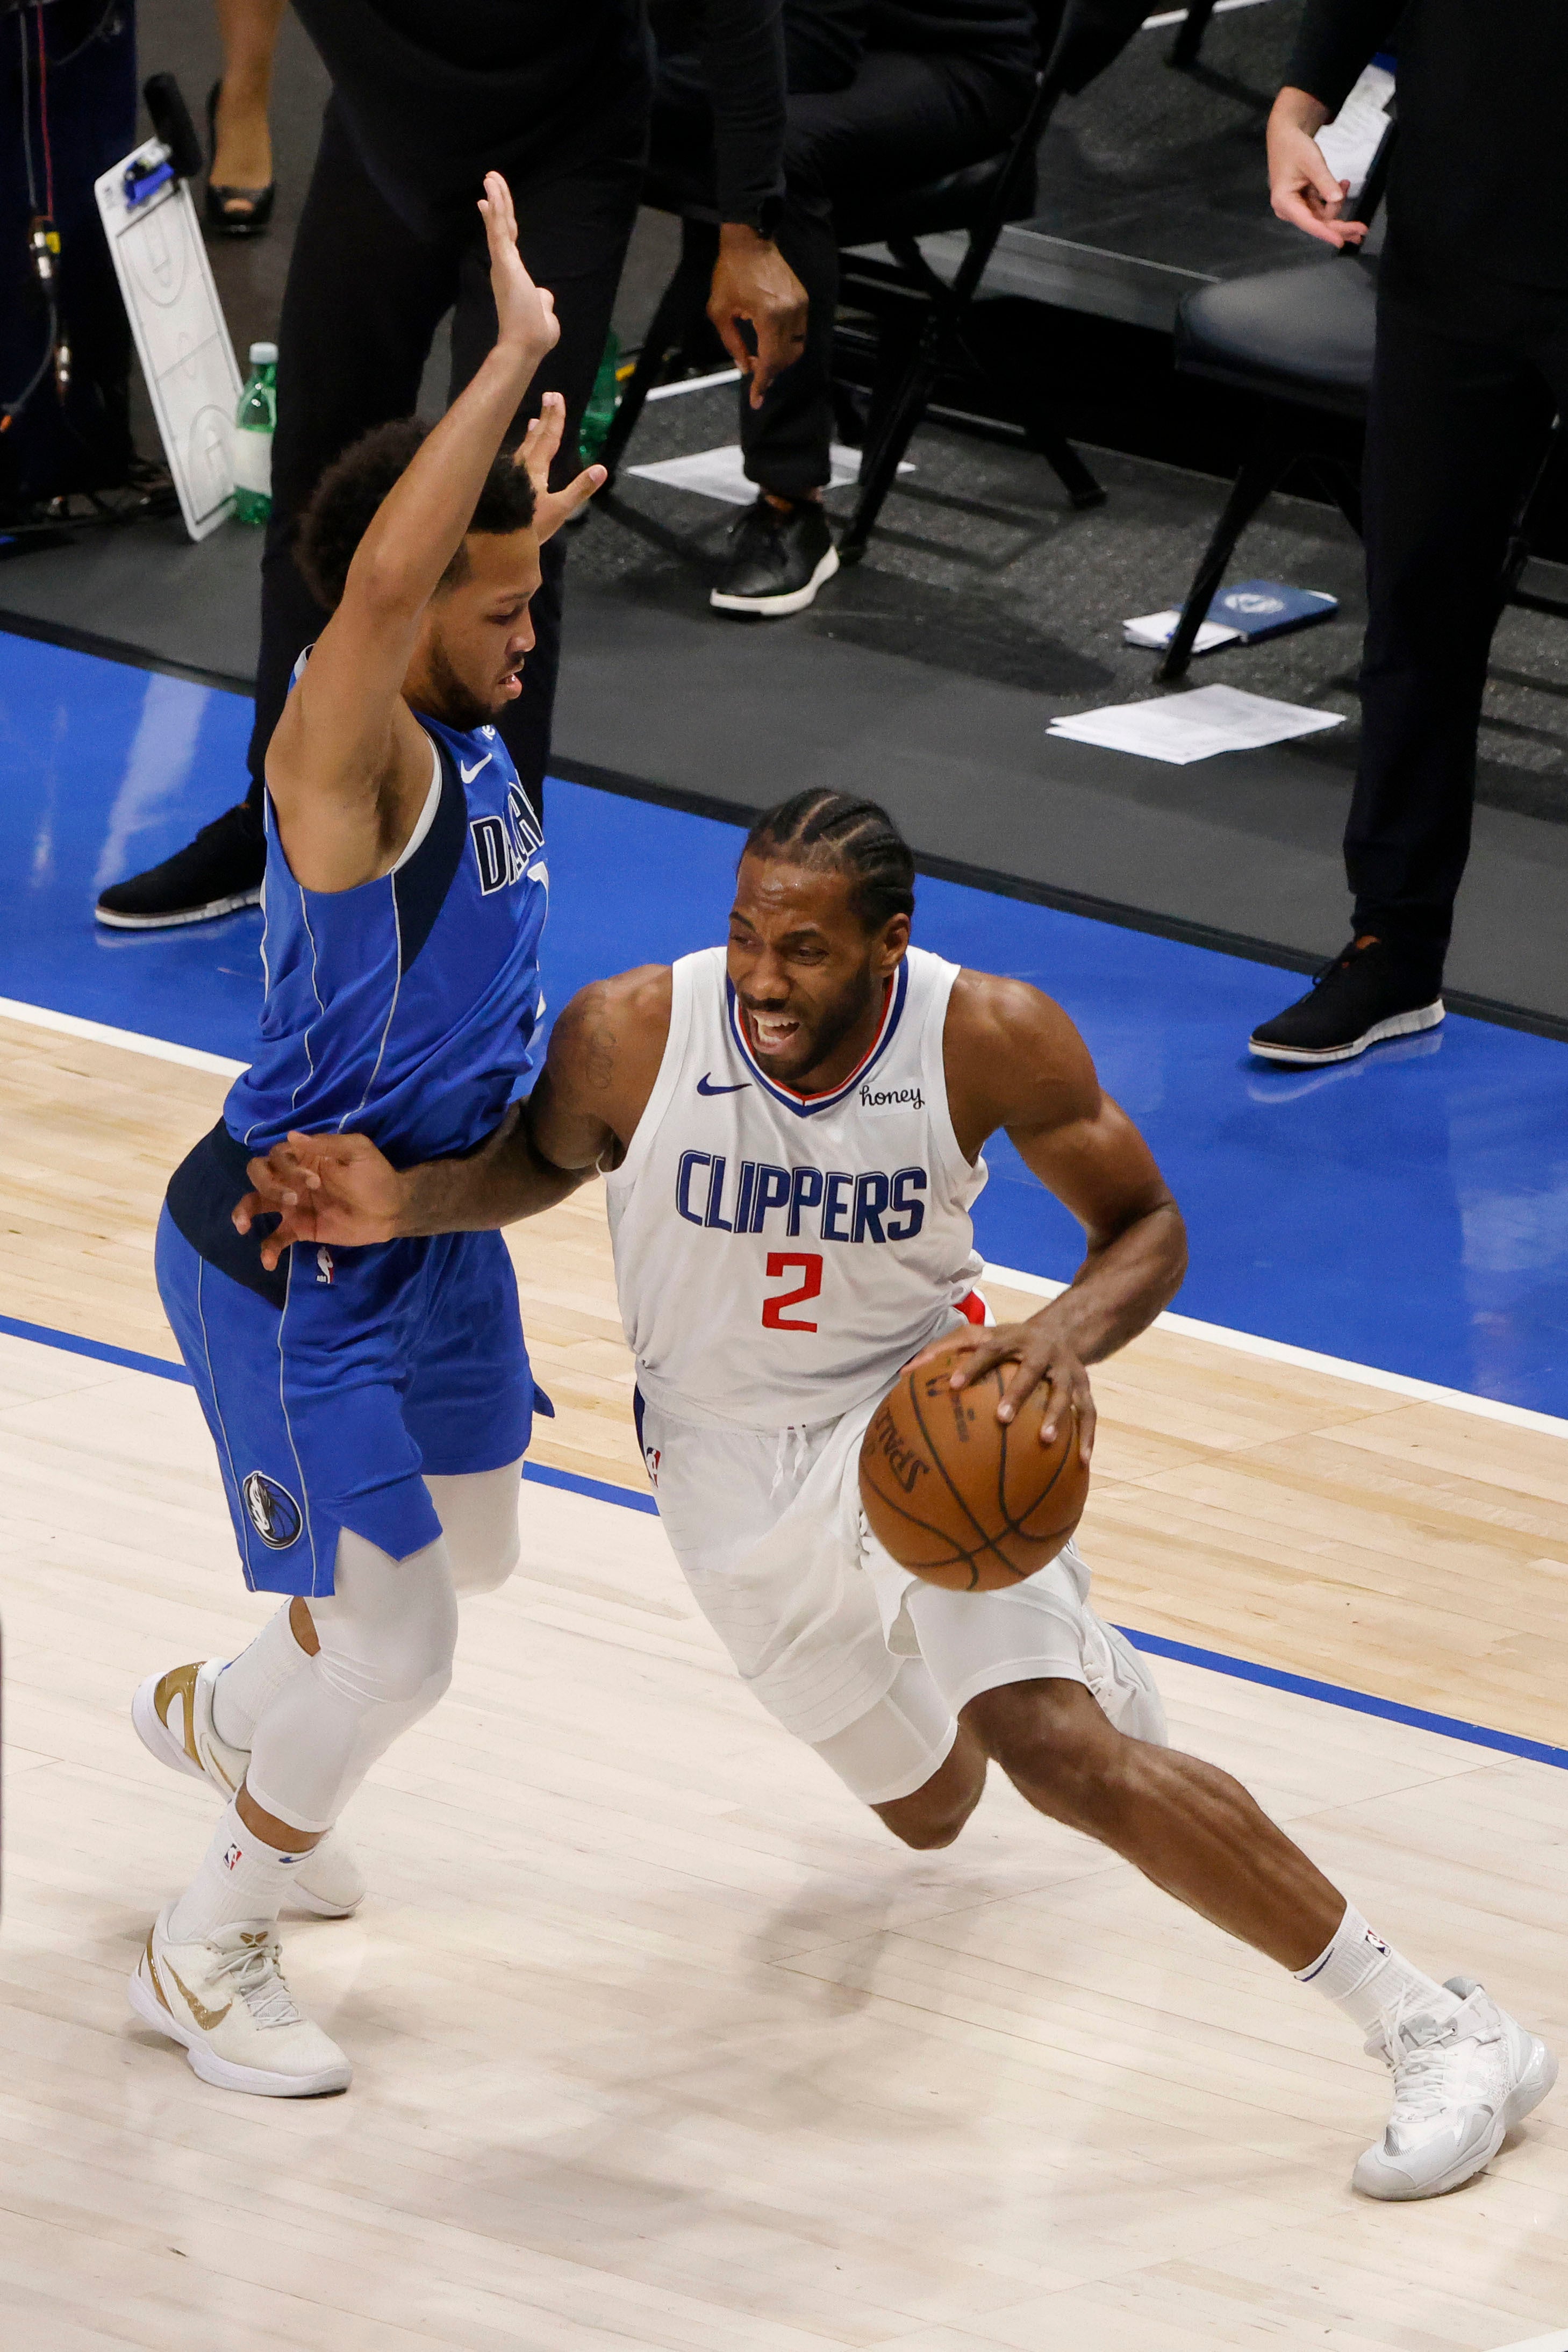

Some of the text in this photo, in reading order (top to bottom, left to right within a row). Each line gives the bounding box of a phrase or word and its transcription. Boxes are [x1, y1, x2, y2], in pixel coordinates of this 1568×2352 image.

[859, 1085, 925, 1110] honey
[675, 1149, 927, 1243] CLIPPERS
[762, 1252, 824, 1333] 2
